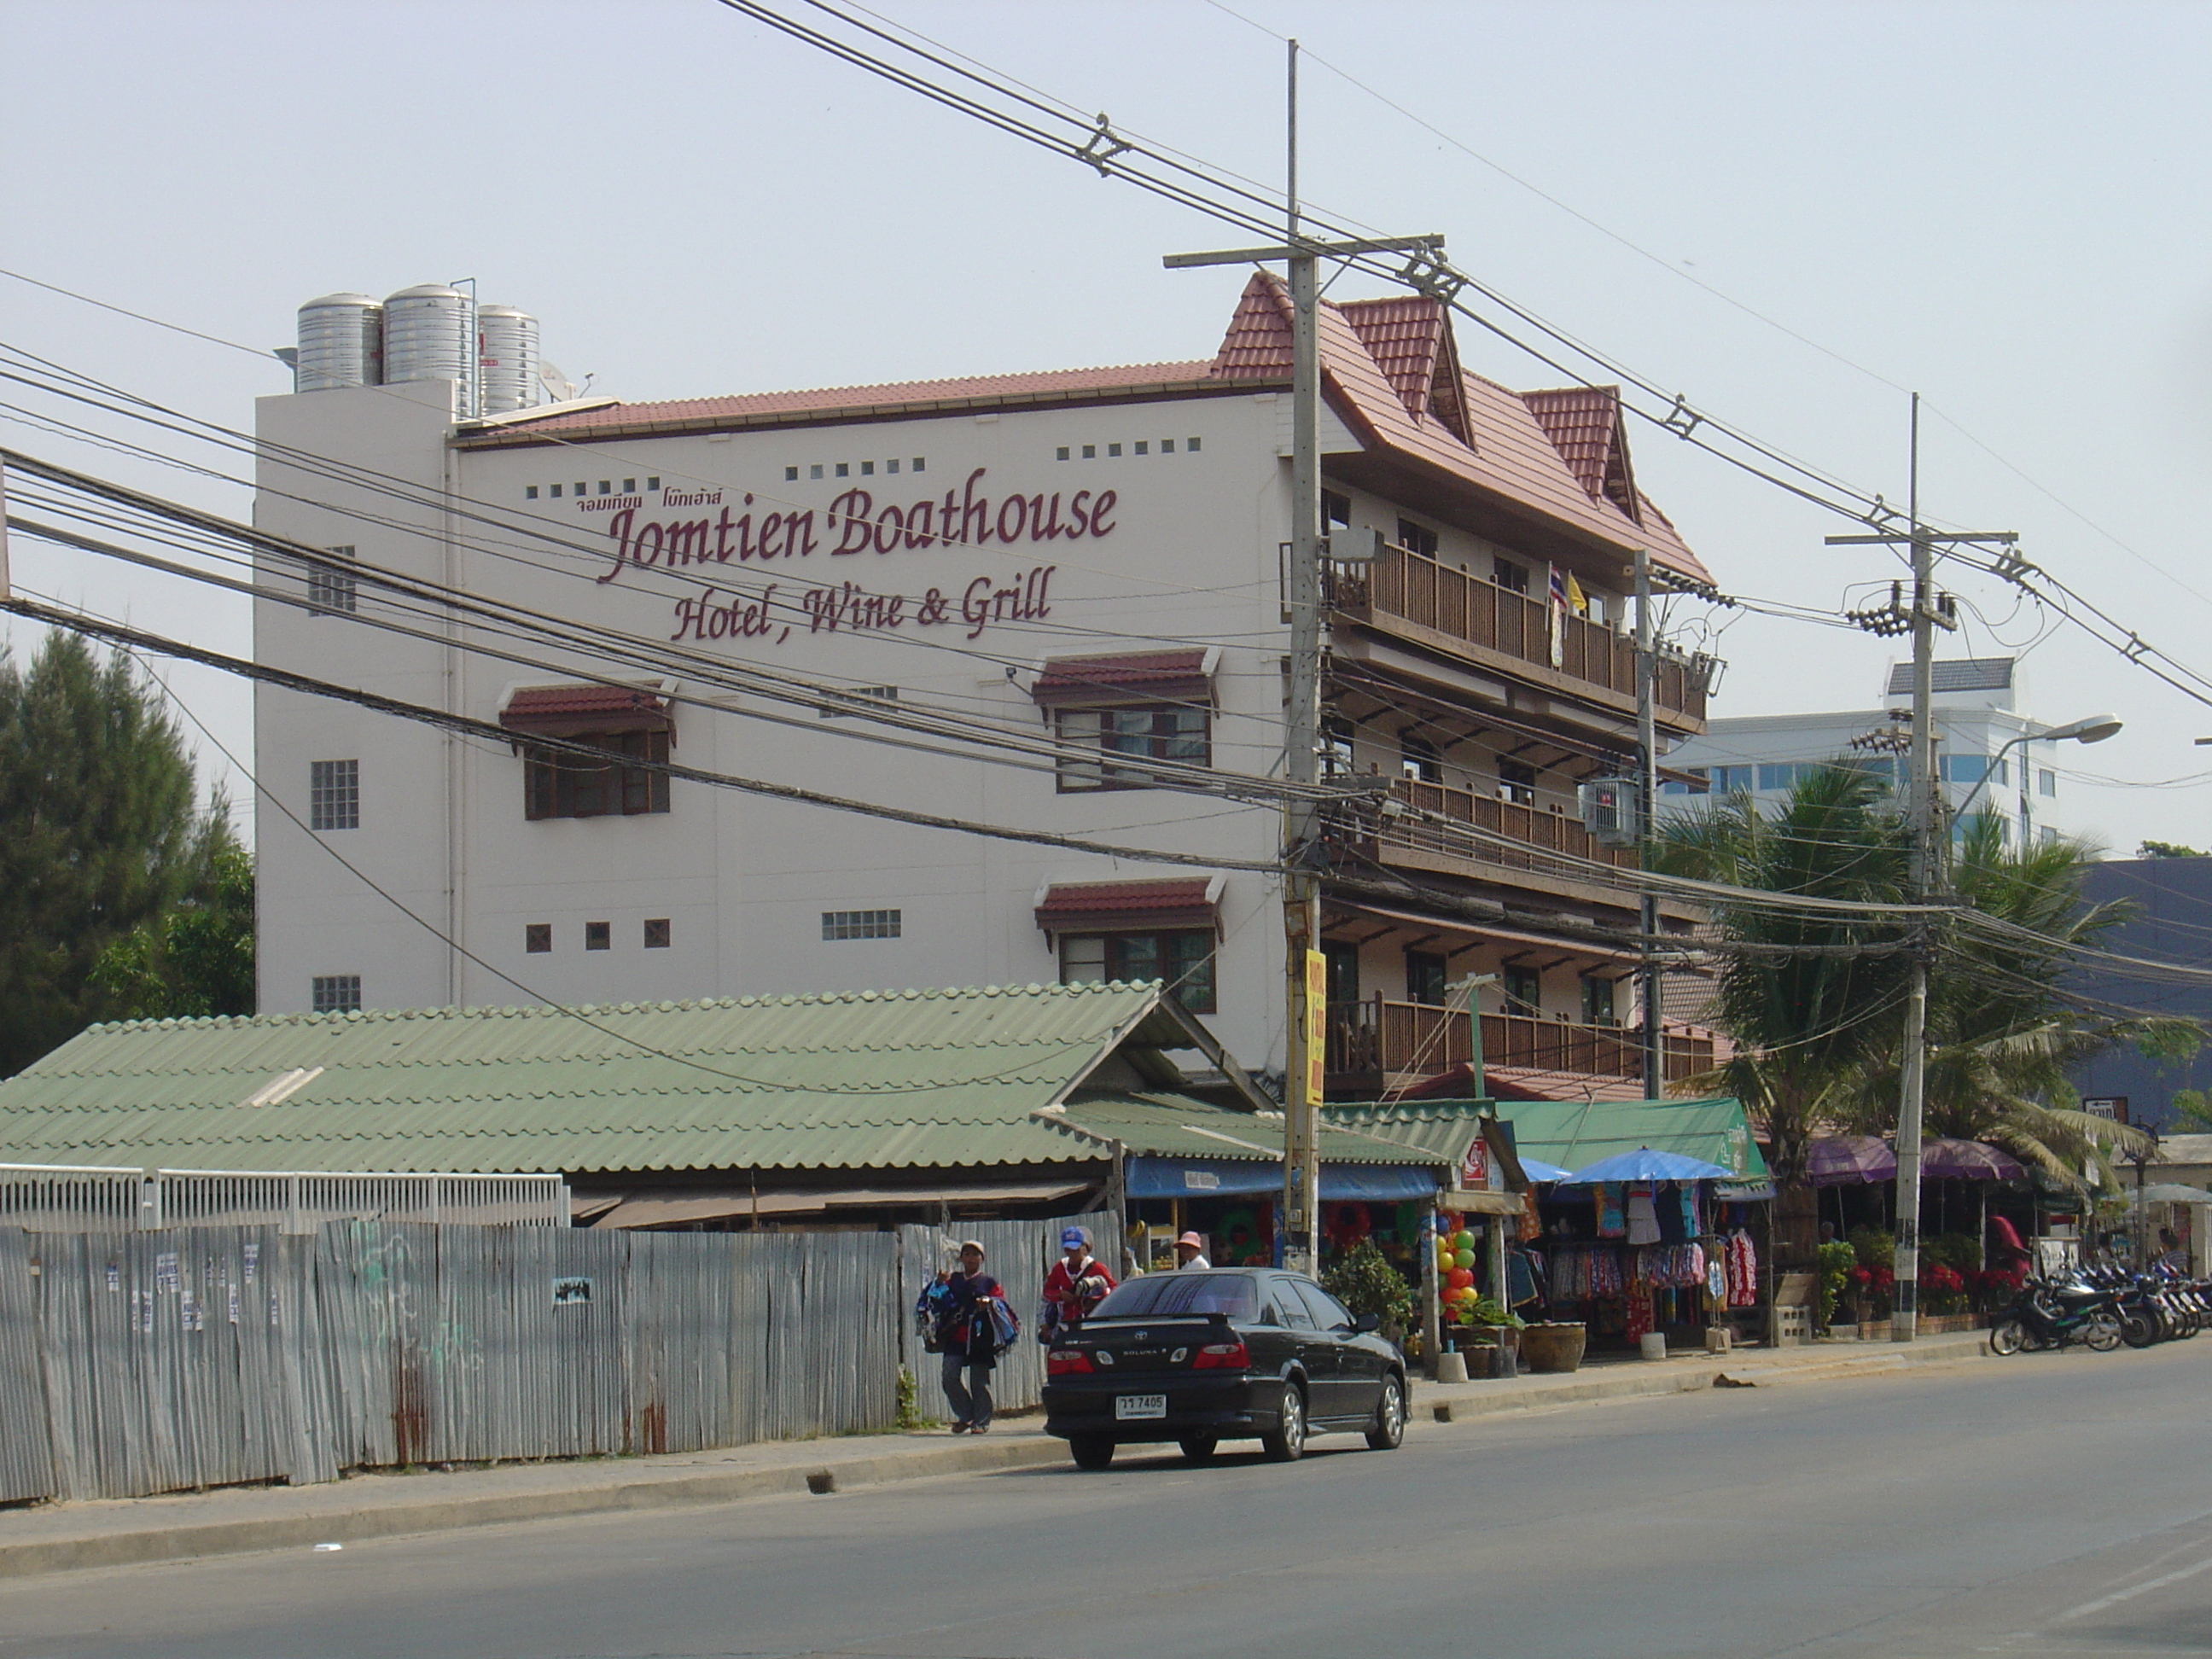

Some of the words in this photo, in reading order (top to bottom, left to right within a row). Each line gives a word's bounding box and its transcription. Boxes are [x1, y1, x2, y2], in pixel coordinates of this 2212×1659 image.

[597, 492, 818, 584] Jomtien
[828, 468, 1117, 556] Boathouse
[671, 583, 790, 645] Hotel,
[803, 580, 905, 634] Wine
[917, 587, 950, 626] &
[963, 565, 1057, 639] Grill
[1138, 1396, 1162, 1407] 7405
